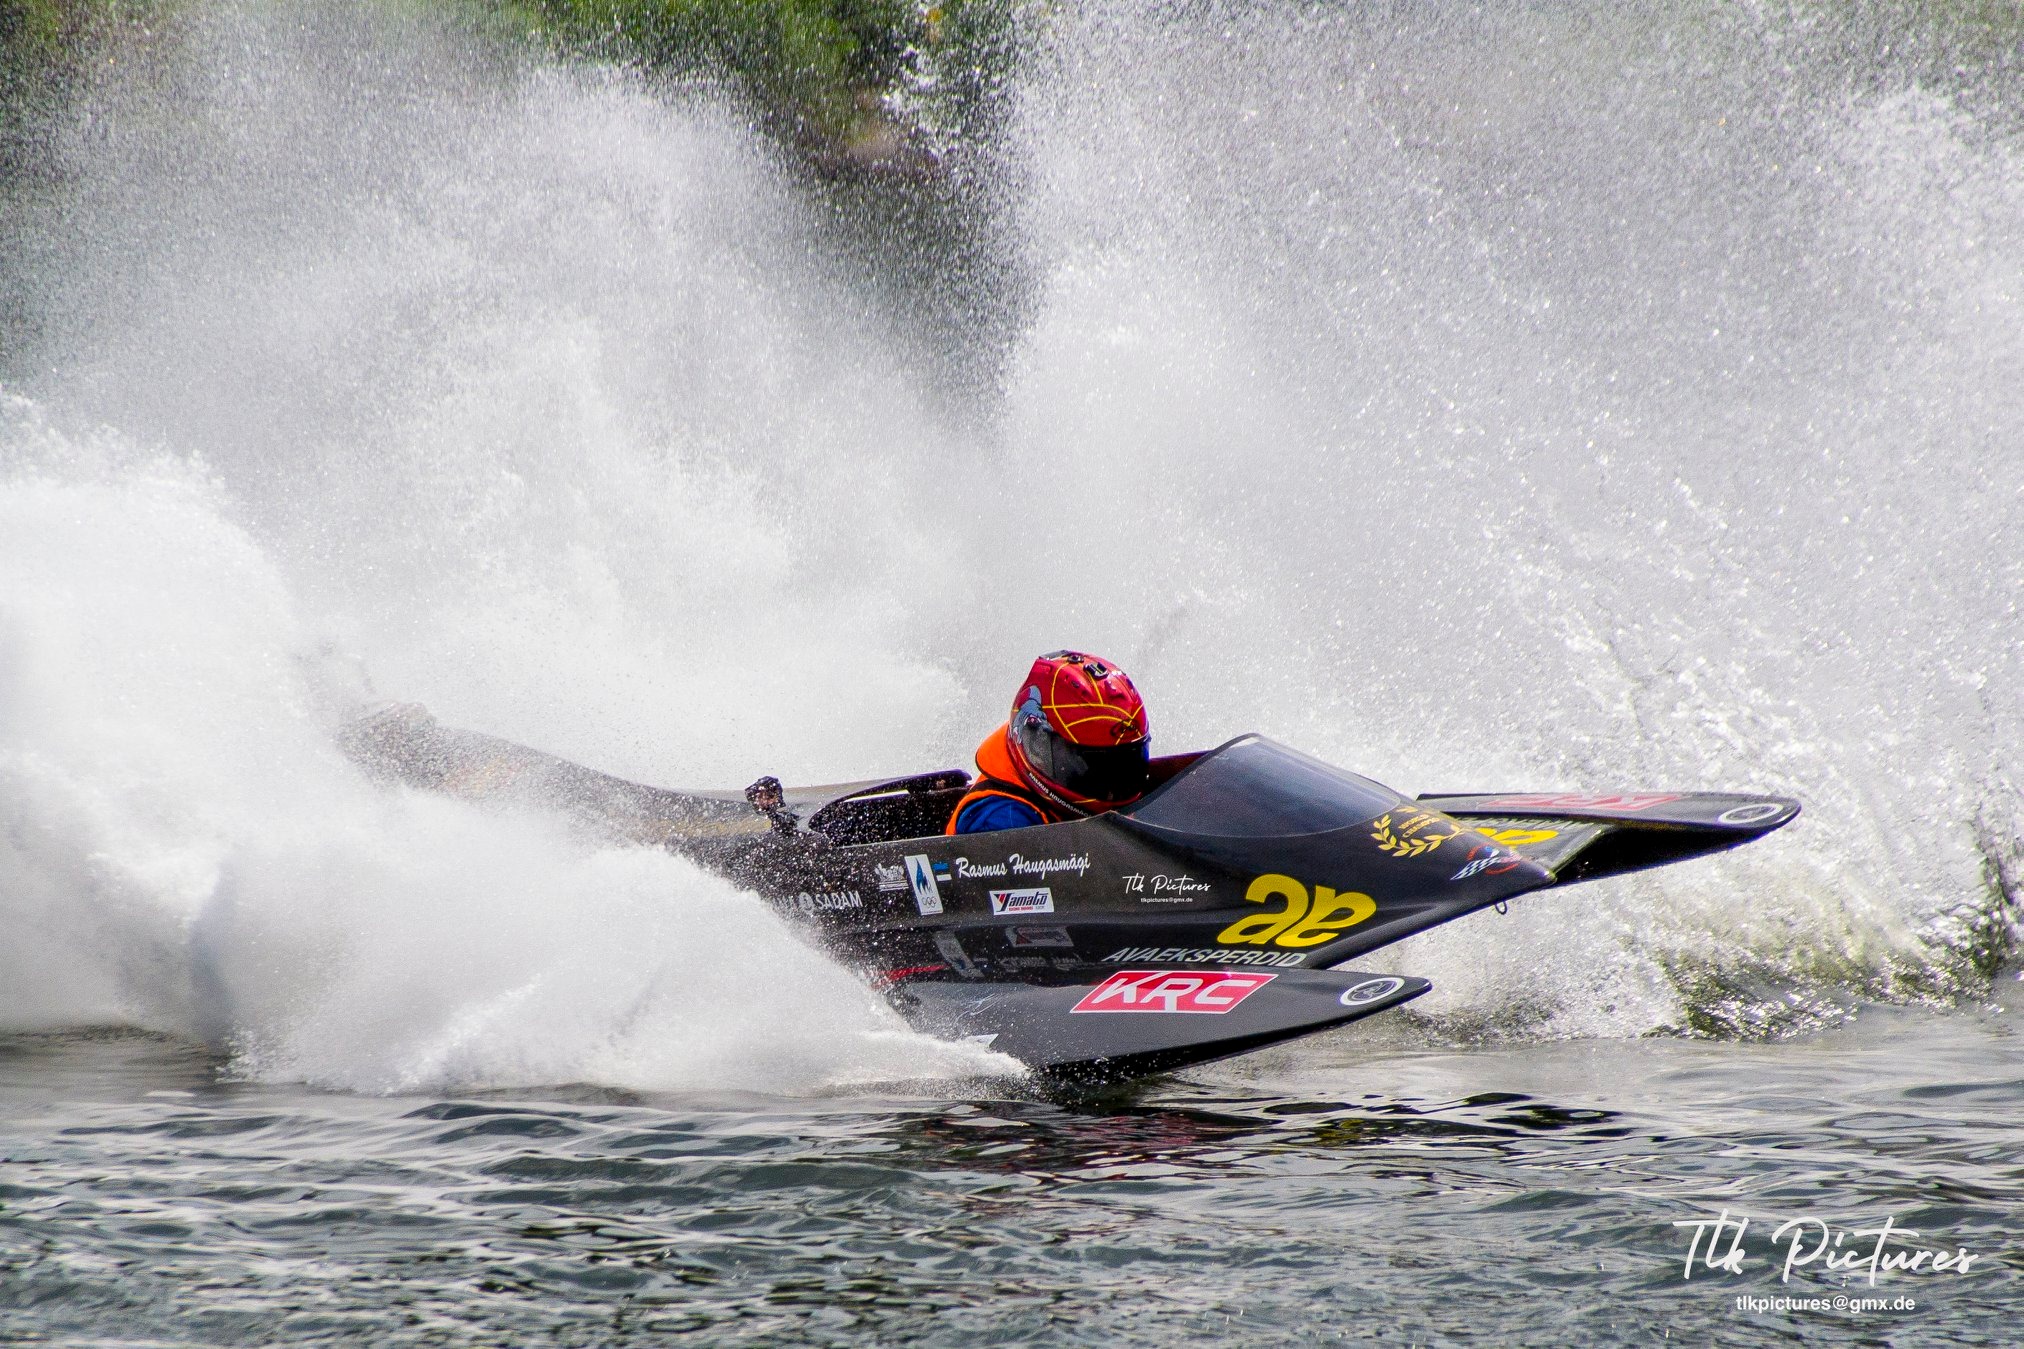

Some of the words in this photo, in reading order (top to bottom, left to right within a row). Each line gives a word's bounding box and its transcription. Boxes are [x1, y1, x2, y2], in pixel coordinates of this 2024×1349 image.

[955, 857, 1008, 878] Rasmus
[1009, 853, 1091, 880] Haugasmägi
[815, 890, 864, 910] SADAM
[993, 891, 1049, 912] Yamato
[1101, 947, 1308, 967] AVAEKSPERDID
[1091, 971, 1258, 1013] KRC
